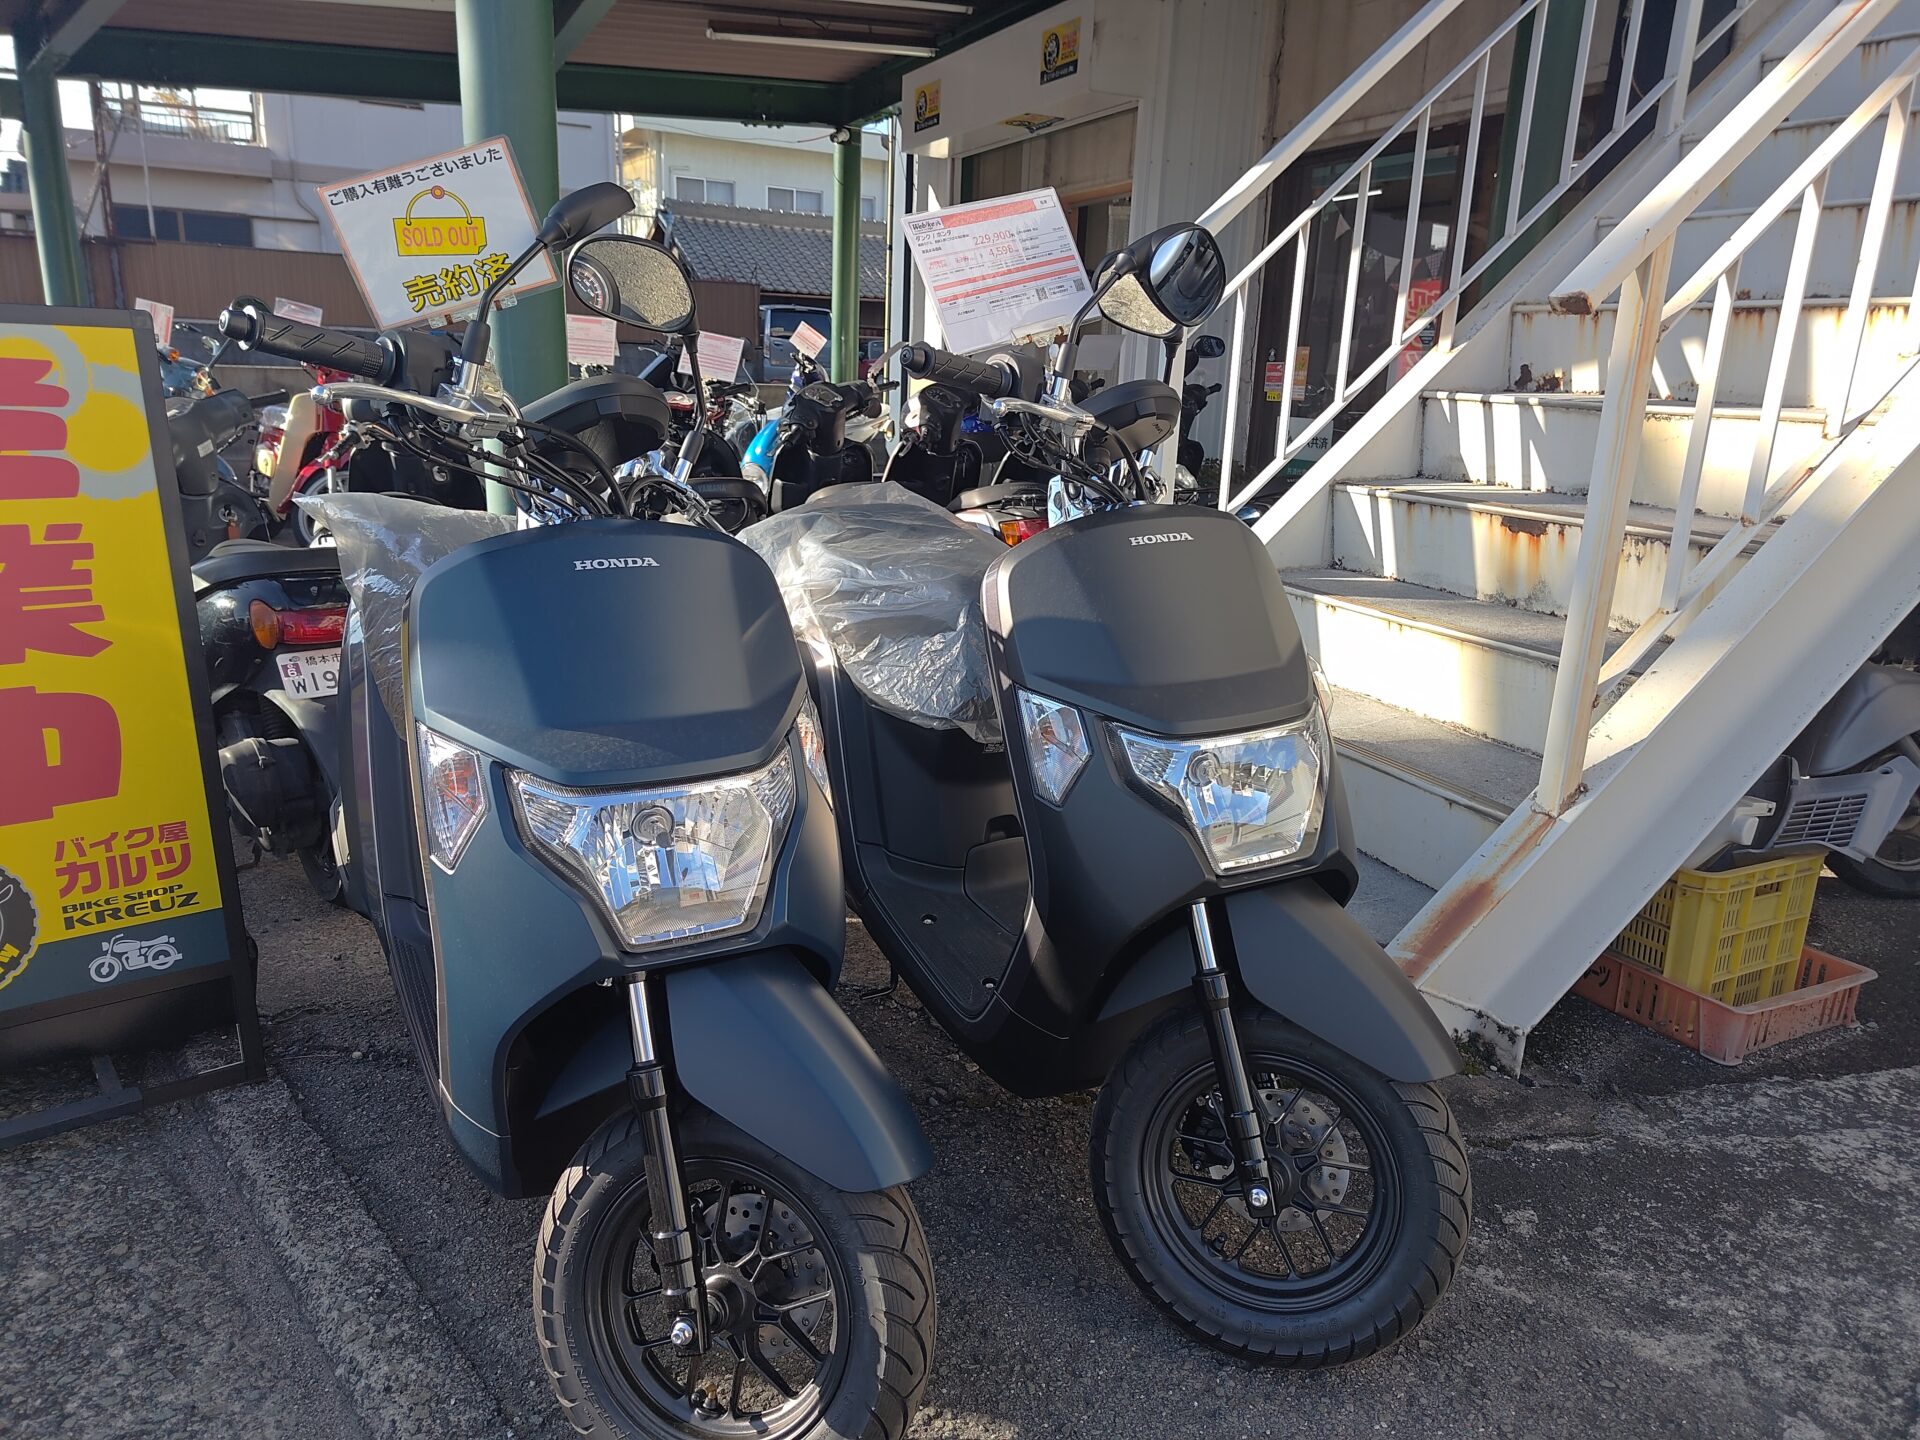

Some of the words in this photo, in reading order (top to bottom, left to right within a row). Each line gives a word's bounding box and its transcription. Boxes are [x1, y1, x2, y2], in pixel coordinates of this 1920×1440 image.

[328, 147, 503, 206] ご購入有難うございました
[402, 226, 444, 247] SOLD
[447, 226, 479, 246] OUT
[402, 252, 517, 312] 売約済
[1128, 532, 1195, 546] HONDA
[573, 557, 660, 571] HONDA
[54, 820, 189, 862] バイク屋
[55, 842, 192, 899] カルツ
[61, 896, 120, 915] BIKE
[123, 883, 183, 903] SHOP
[63, 891, 200, 931] KREUZ
